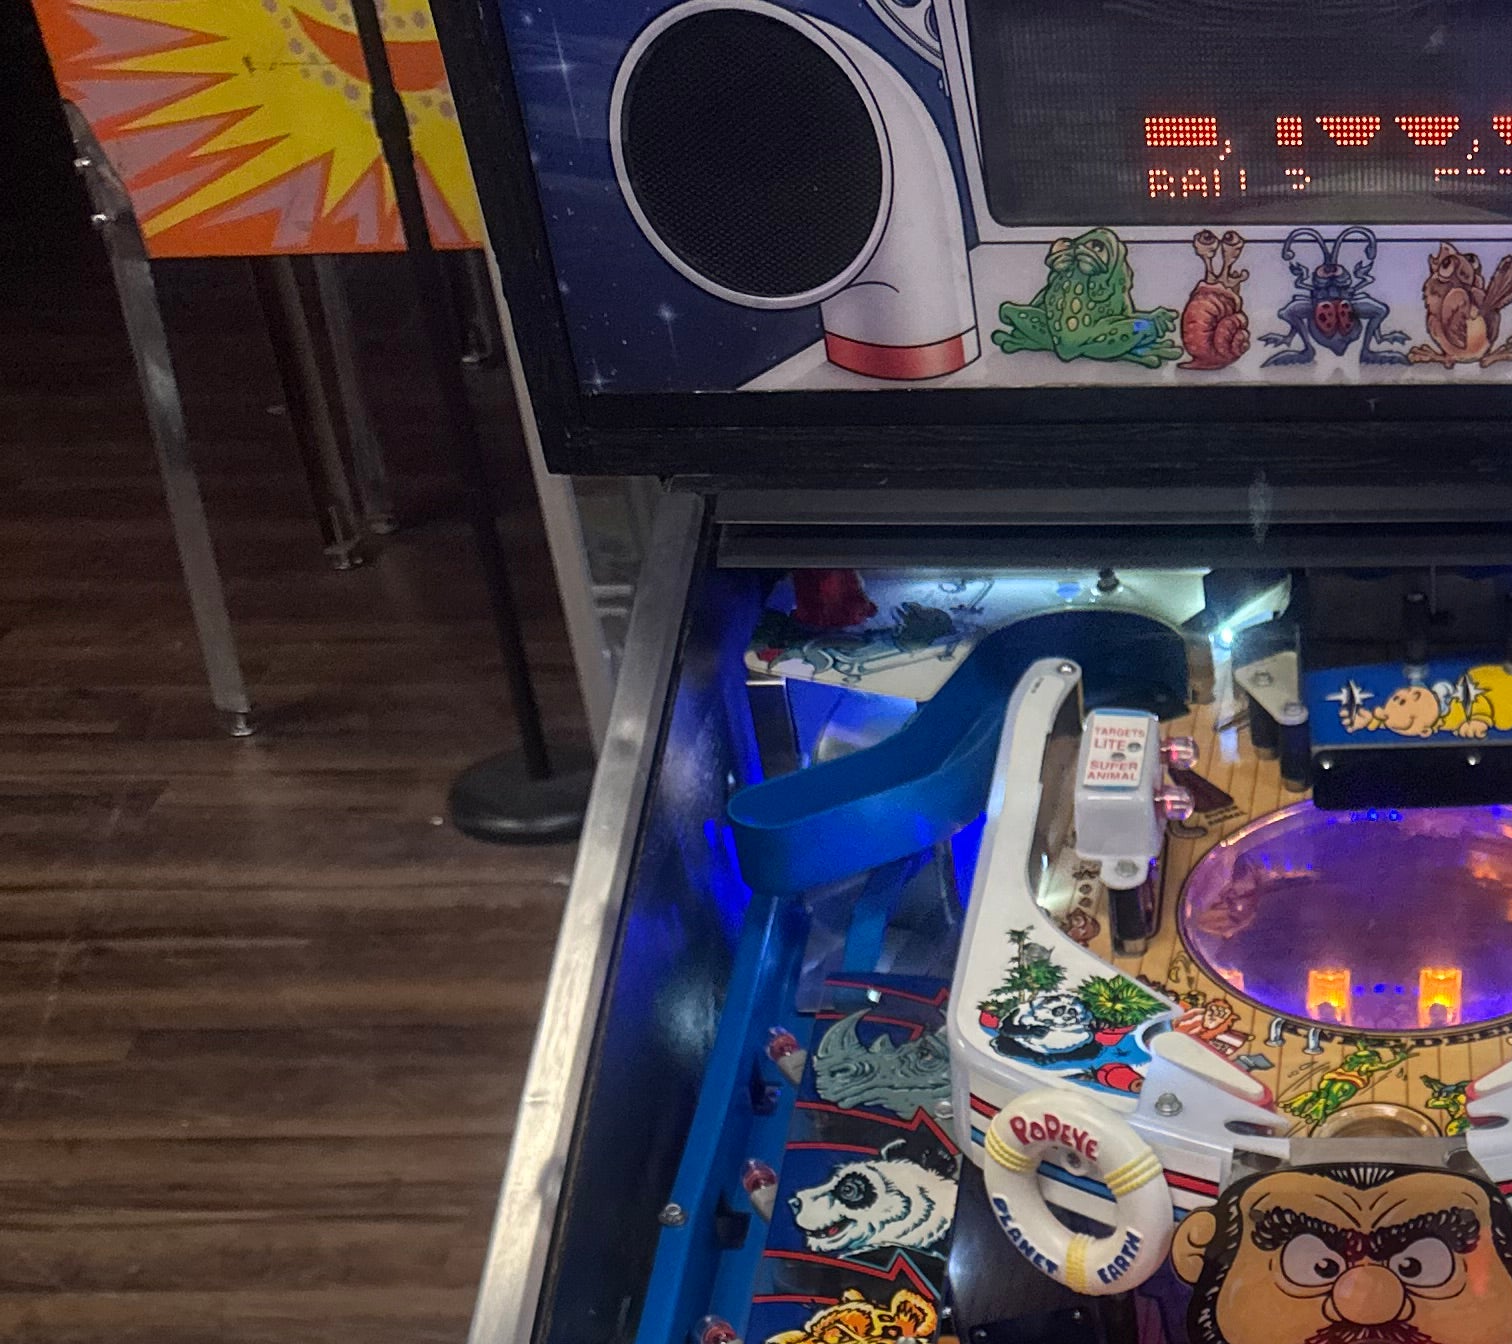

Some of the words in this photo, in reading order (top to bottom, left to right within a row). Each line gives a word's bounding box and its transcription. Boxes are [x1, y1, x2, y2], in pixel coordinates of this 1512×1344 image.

[1094, 738, 1127, 751] LITE
[1090, 760, 1138, 771] SUPER
[1087, 771, 1137, 780] ANIMAL
[1009, 1113, 1099, 1162] POPEYE
[992, 1197, 1059, 1274] PLANET
[1097, 1230, 1142, 1285] EARTH
